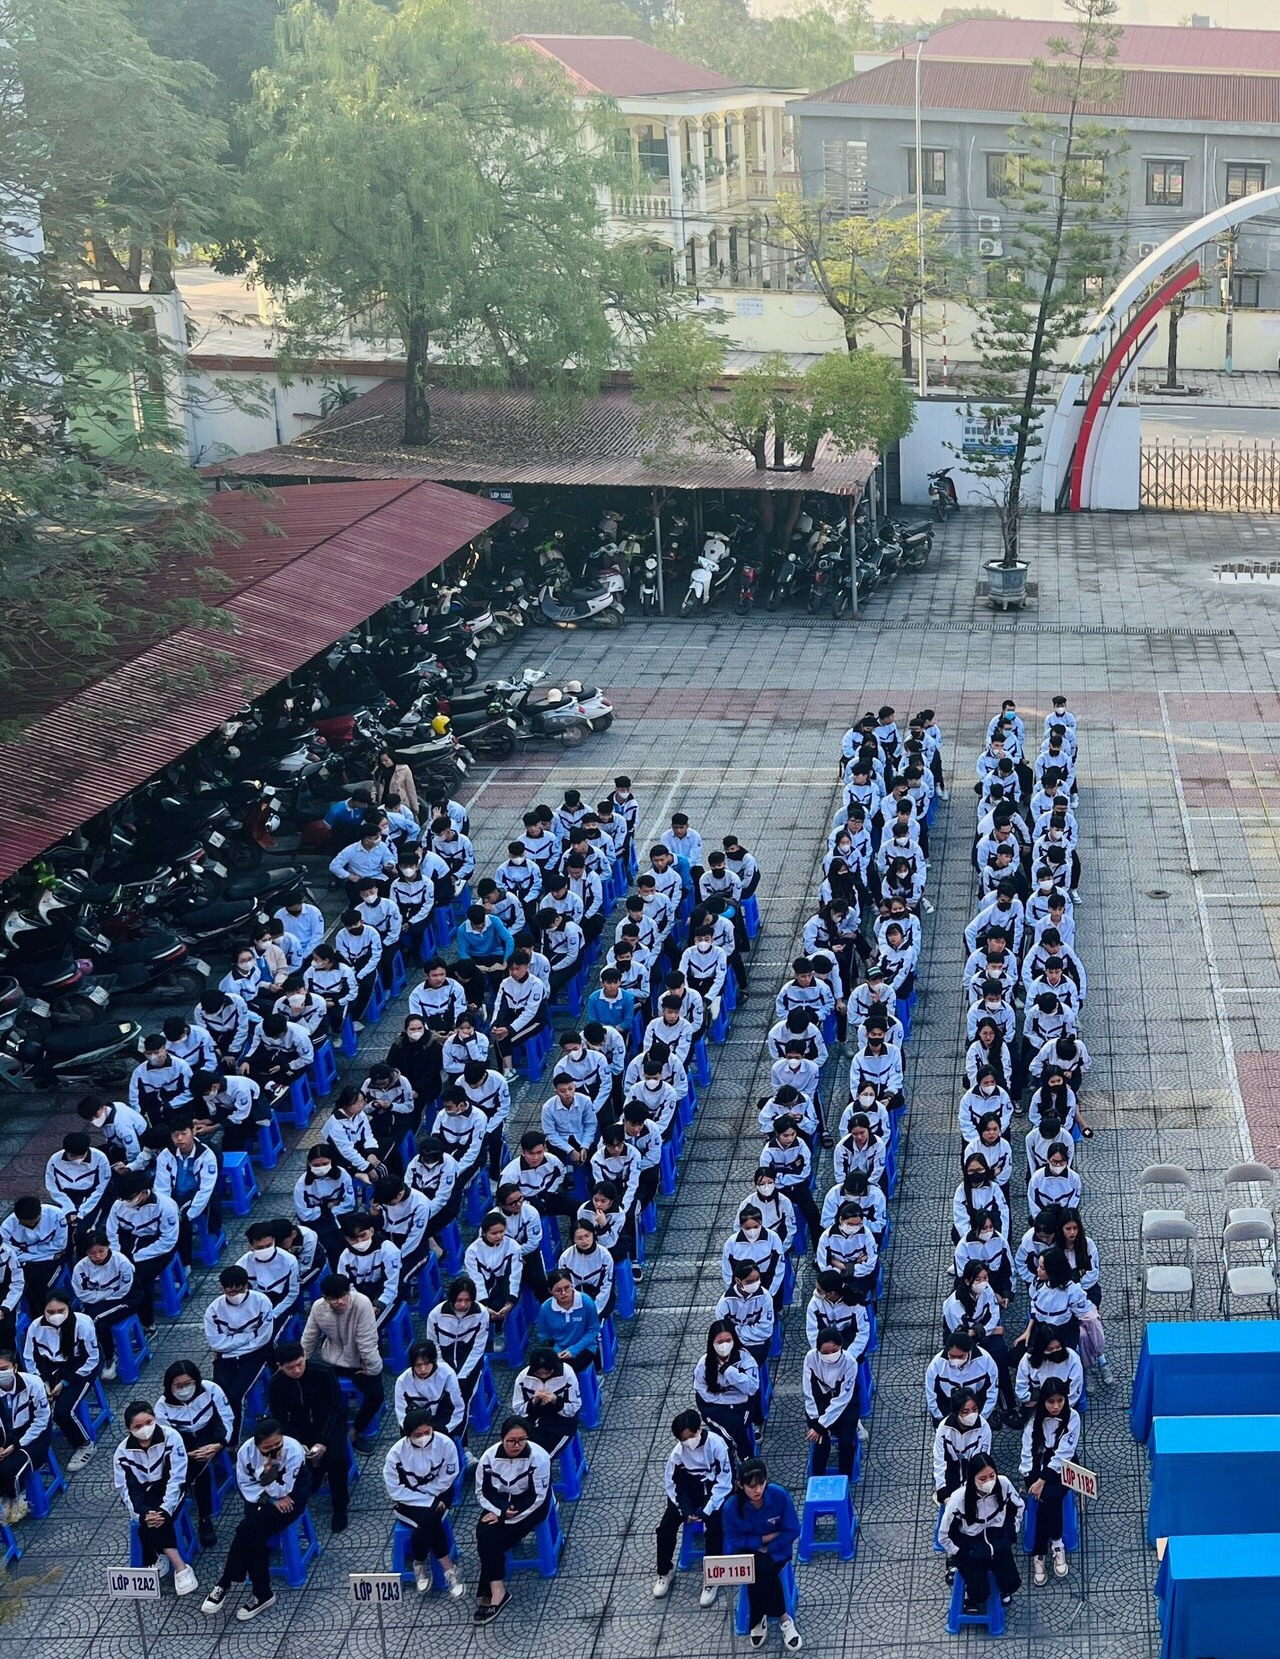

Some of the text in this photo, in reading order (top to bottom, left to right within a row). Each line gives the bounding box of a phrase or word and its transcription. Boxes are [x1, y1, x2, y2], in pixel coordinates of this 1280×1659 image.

[1062, 1465, 1095, 1496] LỚP 11B2
[707, 1564, 751, 1578] LỚP 11B1
[112, 1573, 156, 1591] LỚP 12A2
[353, 1578, 400, 1601] LỚP 12A3
